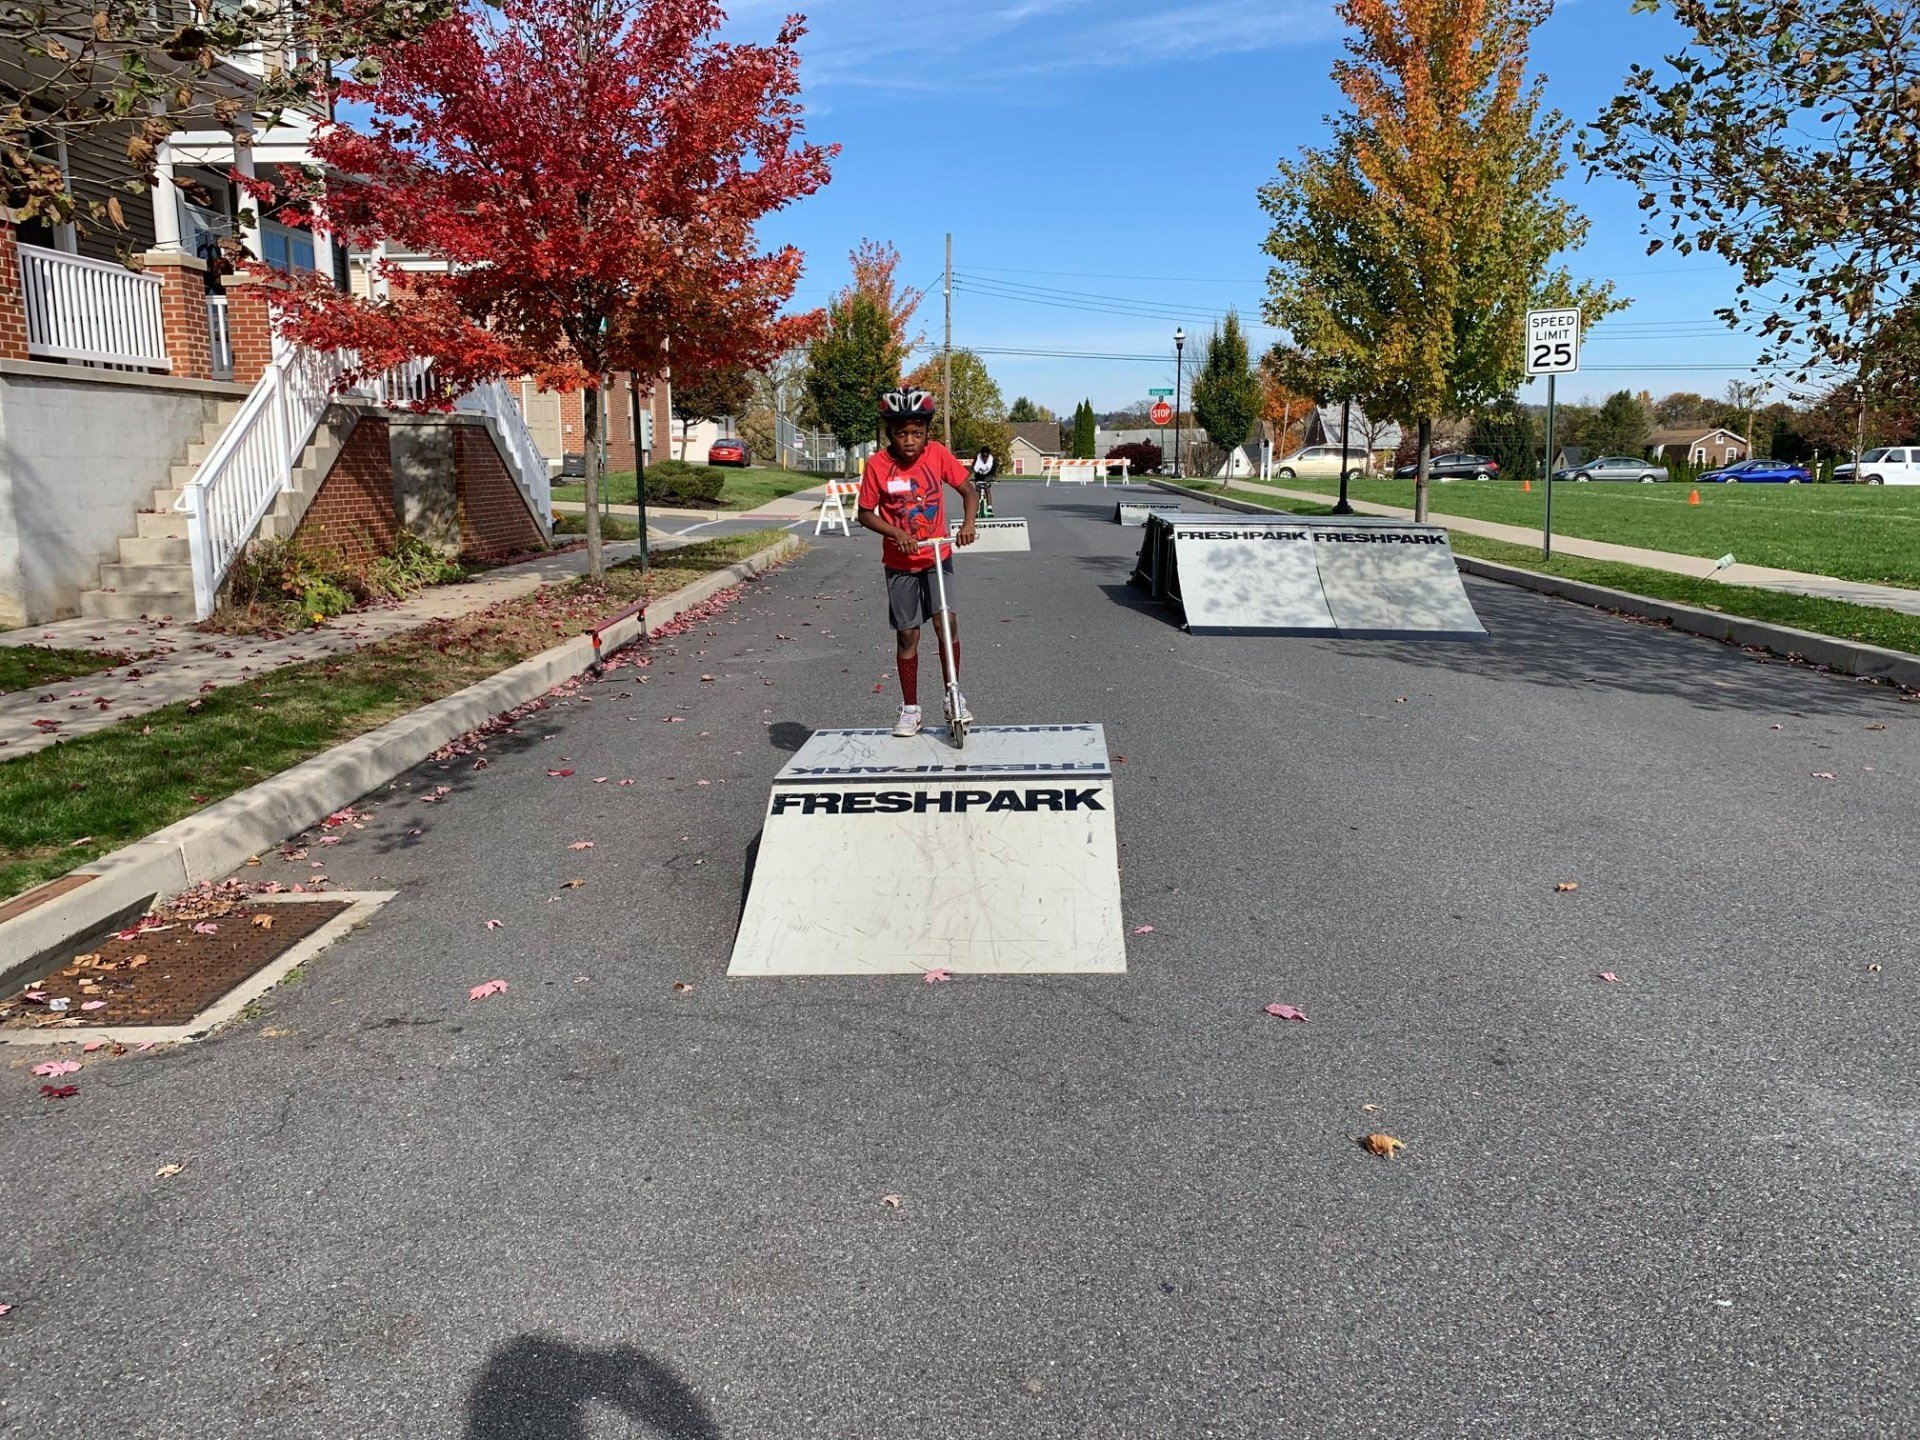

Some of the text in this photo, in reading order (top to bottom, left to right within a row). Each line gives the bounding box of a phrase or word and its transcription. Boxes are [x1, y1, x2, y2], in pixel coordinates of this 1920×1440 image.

[1532, 316, 1574, 328] SPEED
[1536, 329, 1570, 341] LIMIT
[1533, 343, 1571, 367] 25
[1153, 409, 1170, 418] STOP
[1177, 531, 1309, 542] FRESHPARK
[1313, 533, 1447, 545] FRESHPARK
[790, 762, 1106, 775] FRESHPARK
[771, 788, 1106, 816] FRESHPARK
